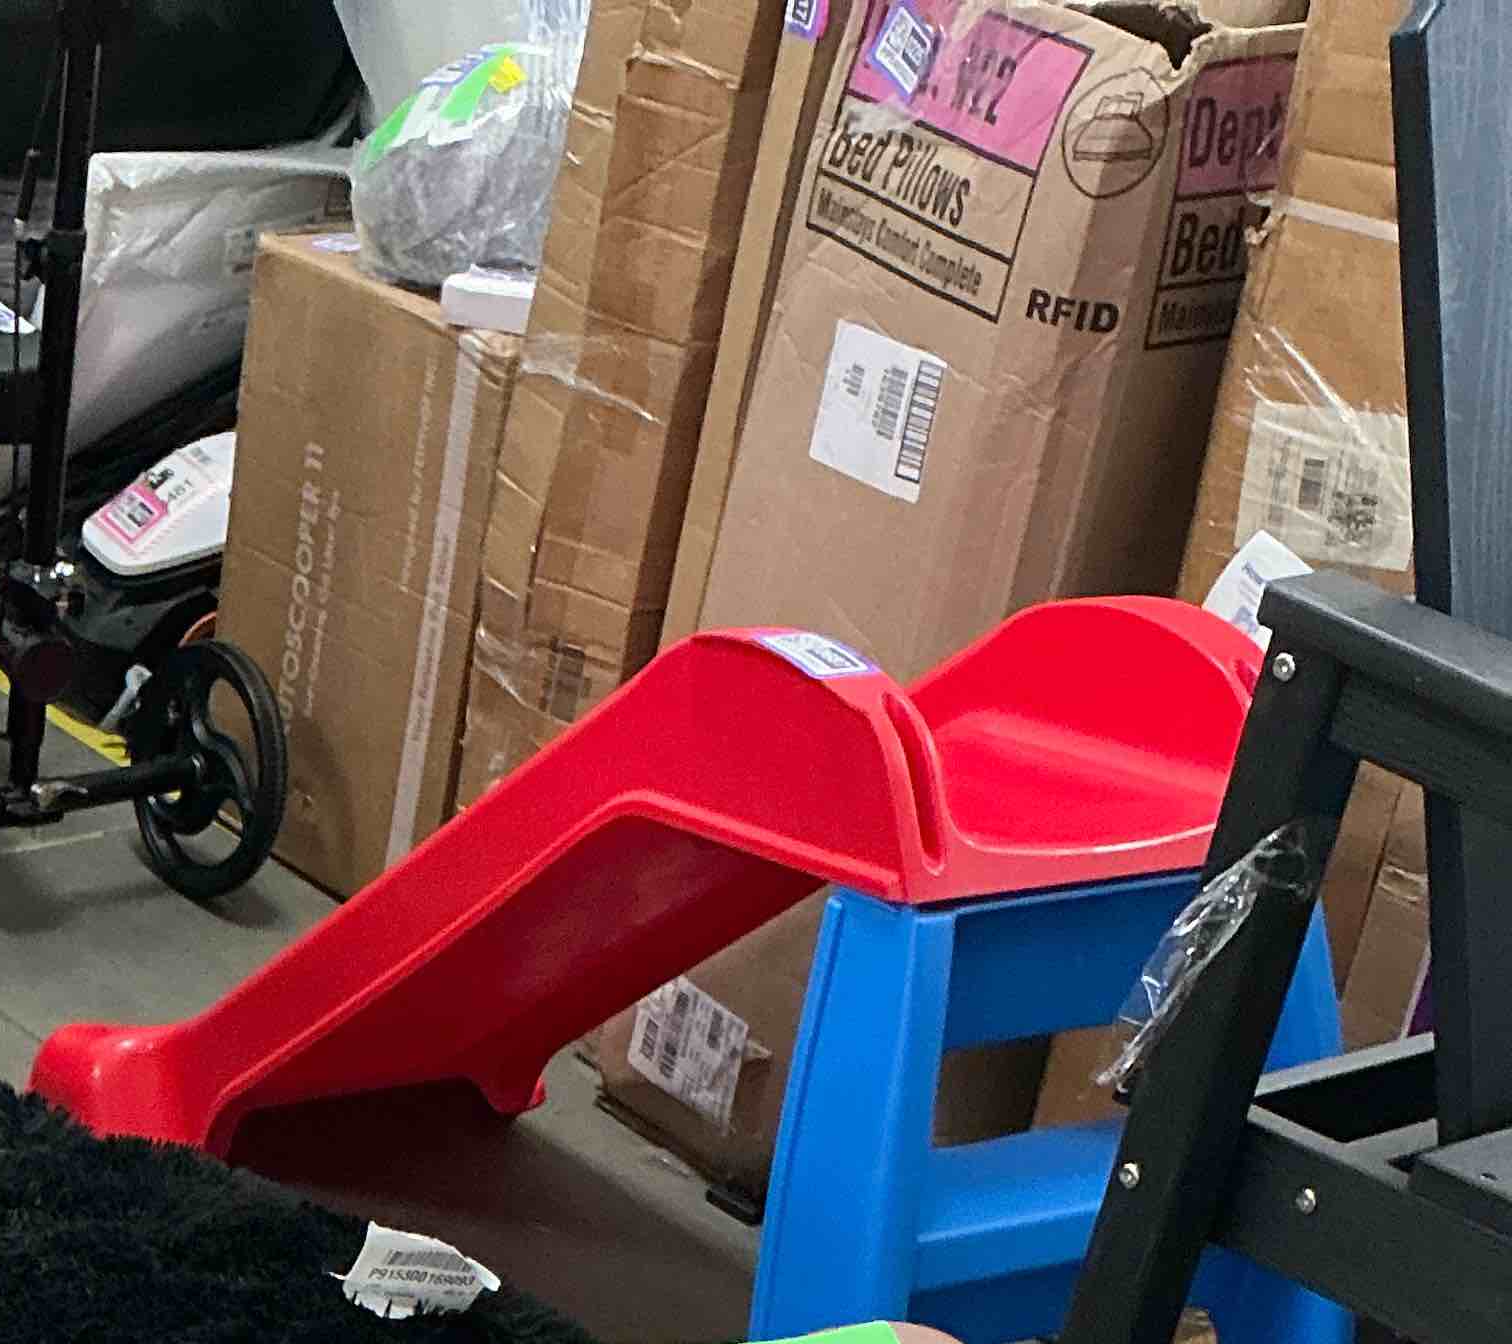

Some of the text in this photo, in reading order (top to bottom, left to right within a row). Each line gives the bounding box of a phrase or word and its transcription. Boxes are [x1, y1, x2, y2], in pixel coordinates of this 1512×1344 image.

[882, 132, 971, 227] Pillows
[918, 241, 982, 296] Complete
[1025, 287, 1120, 334] RFID
[274, 480, 320, 728] UTOSCOOPER
